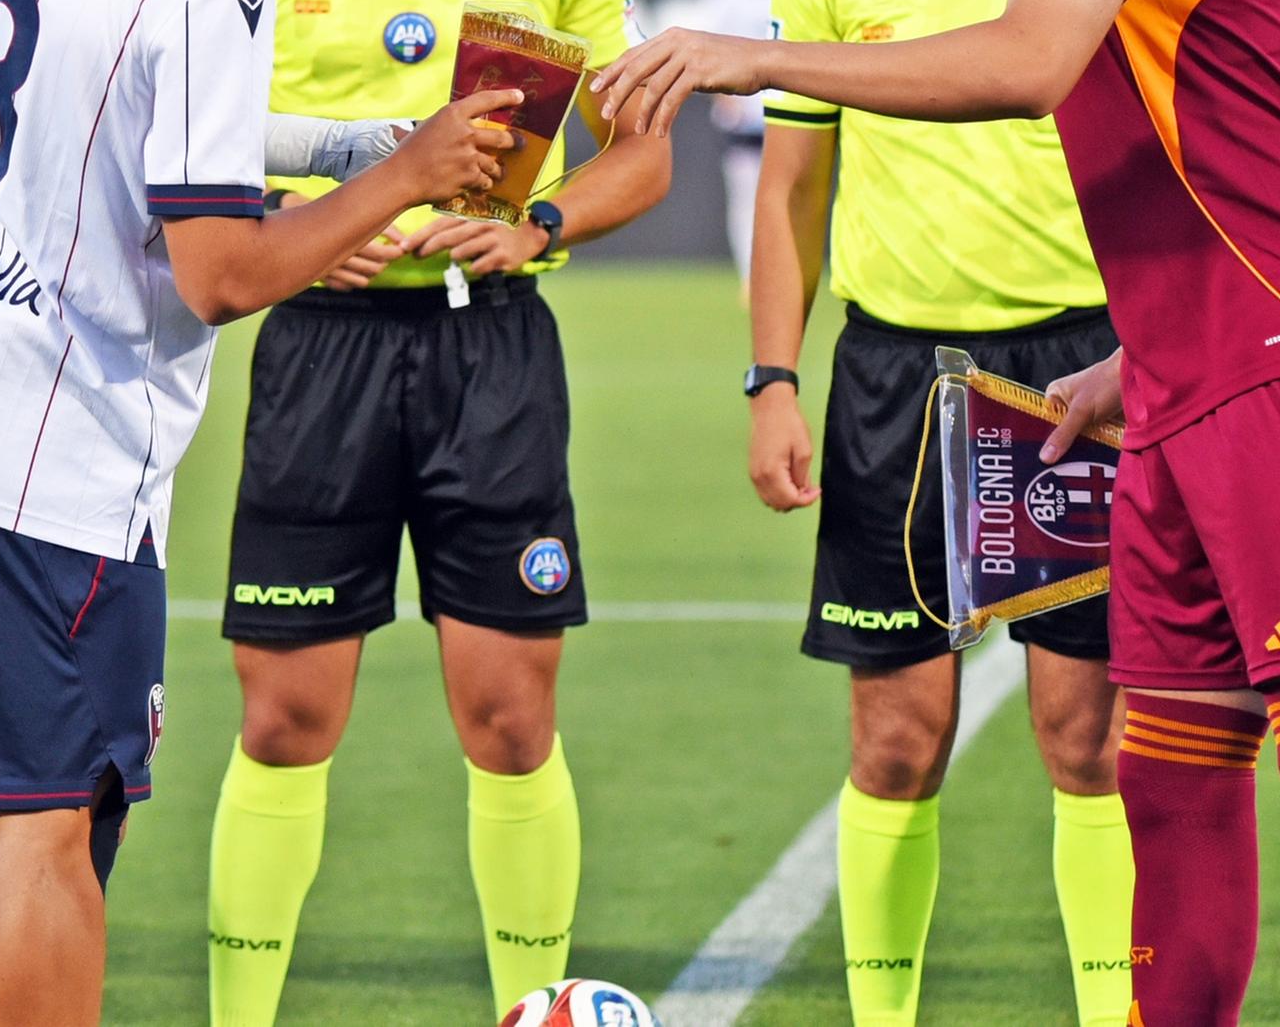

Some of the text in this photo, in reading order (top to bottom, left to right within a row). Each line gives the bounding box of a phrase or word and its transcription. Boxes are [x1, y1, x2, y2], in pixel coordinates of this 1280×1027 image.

[977, 427, 1016, 575] BOLOGNA FC
[1029, 482, 1056, 523] BFC
[1055, 489, 1065, 517] 1909
[234, 583, 335, 606] GIVOVA
[821, 601, 920, 631] GIVOVA
[209, 932, 282, 950] VOVA
[1082, 960, 1131, 972] GIVO
